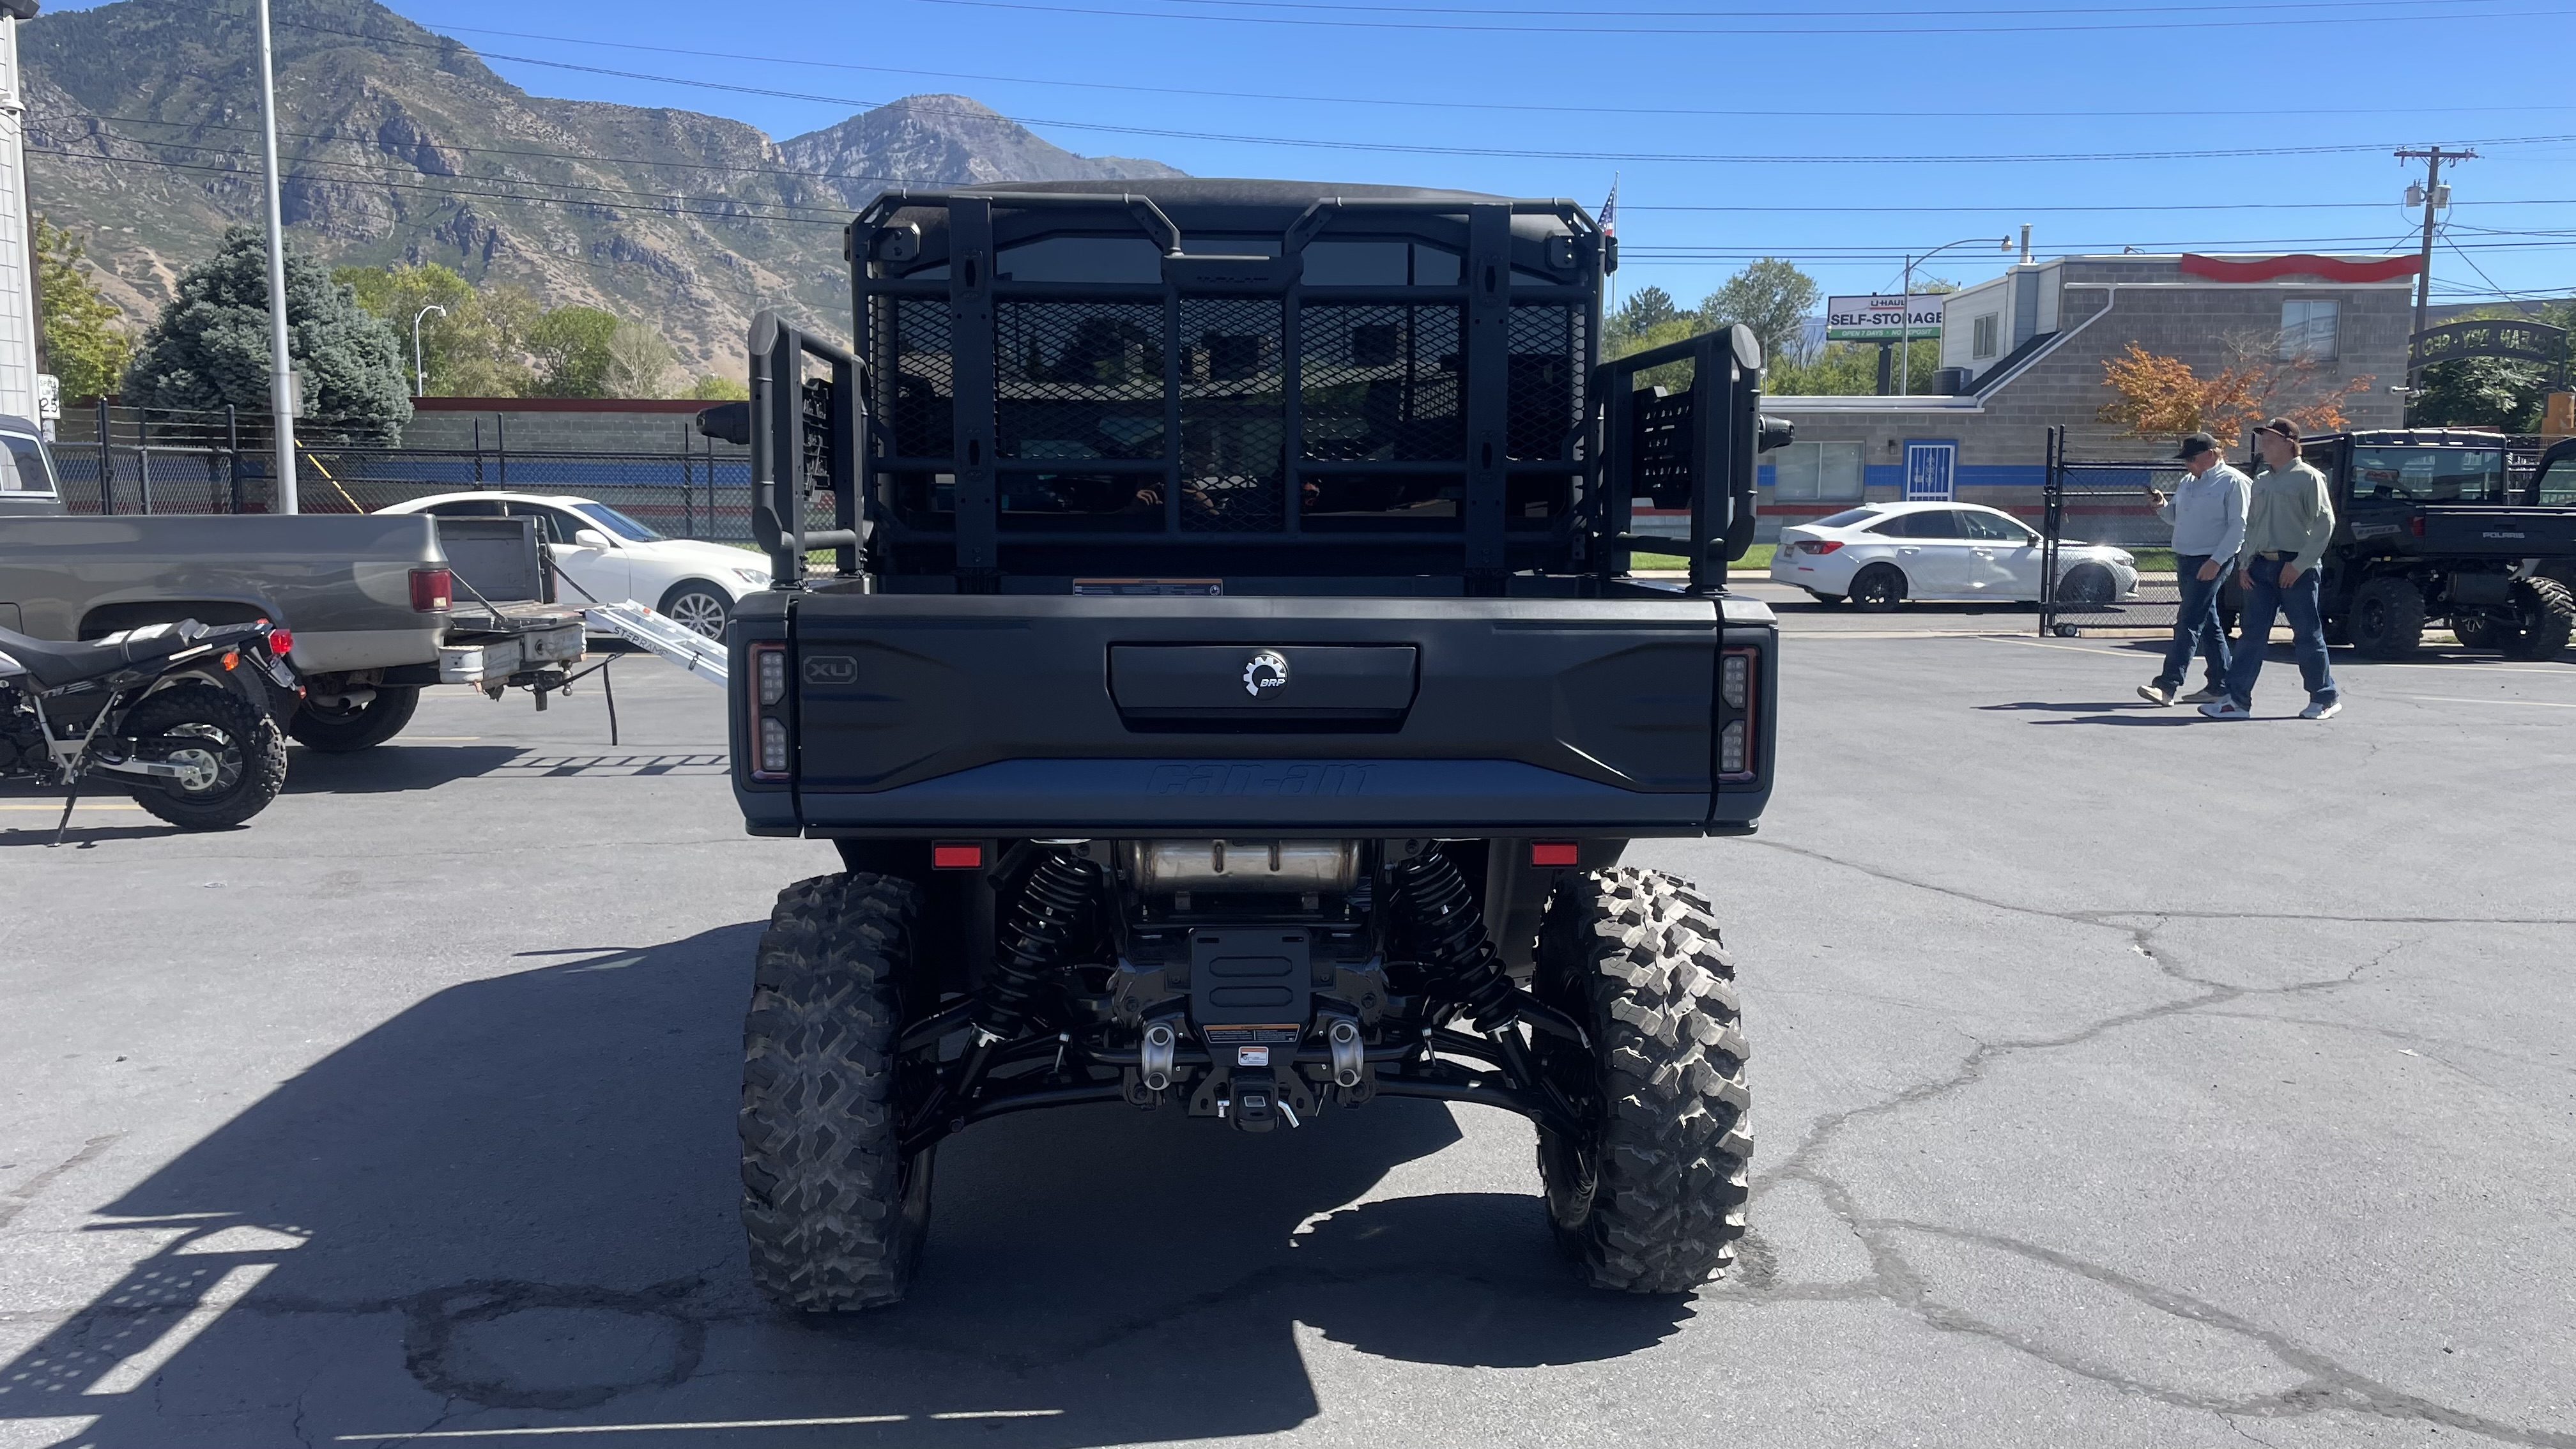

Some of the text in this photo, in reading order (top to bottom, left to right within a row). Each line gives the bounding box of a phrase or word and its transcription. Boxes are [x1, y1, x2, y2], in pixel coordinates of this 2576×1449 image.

[1830, 312, 1942, 325] SELF-STORAGE
[40, 397, 57, 413] 25
[809, 663, 852, 677] XU
[1260, 678, 1285, 687] BRP
